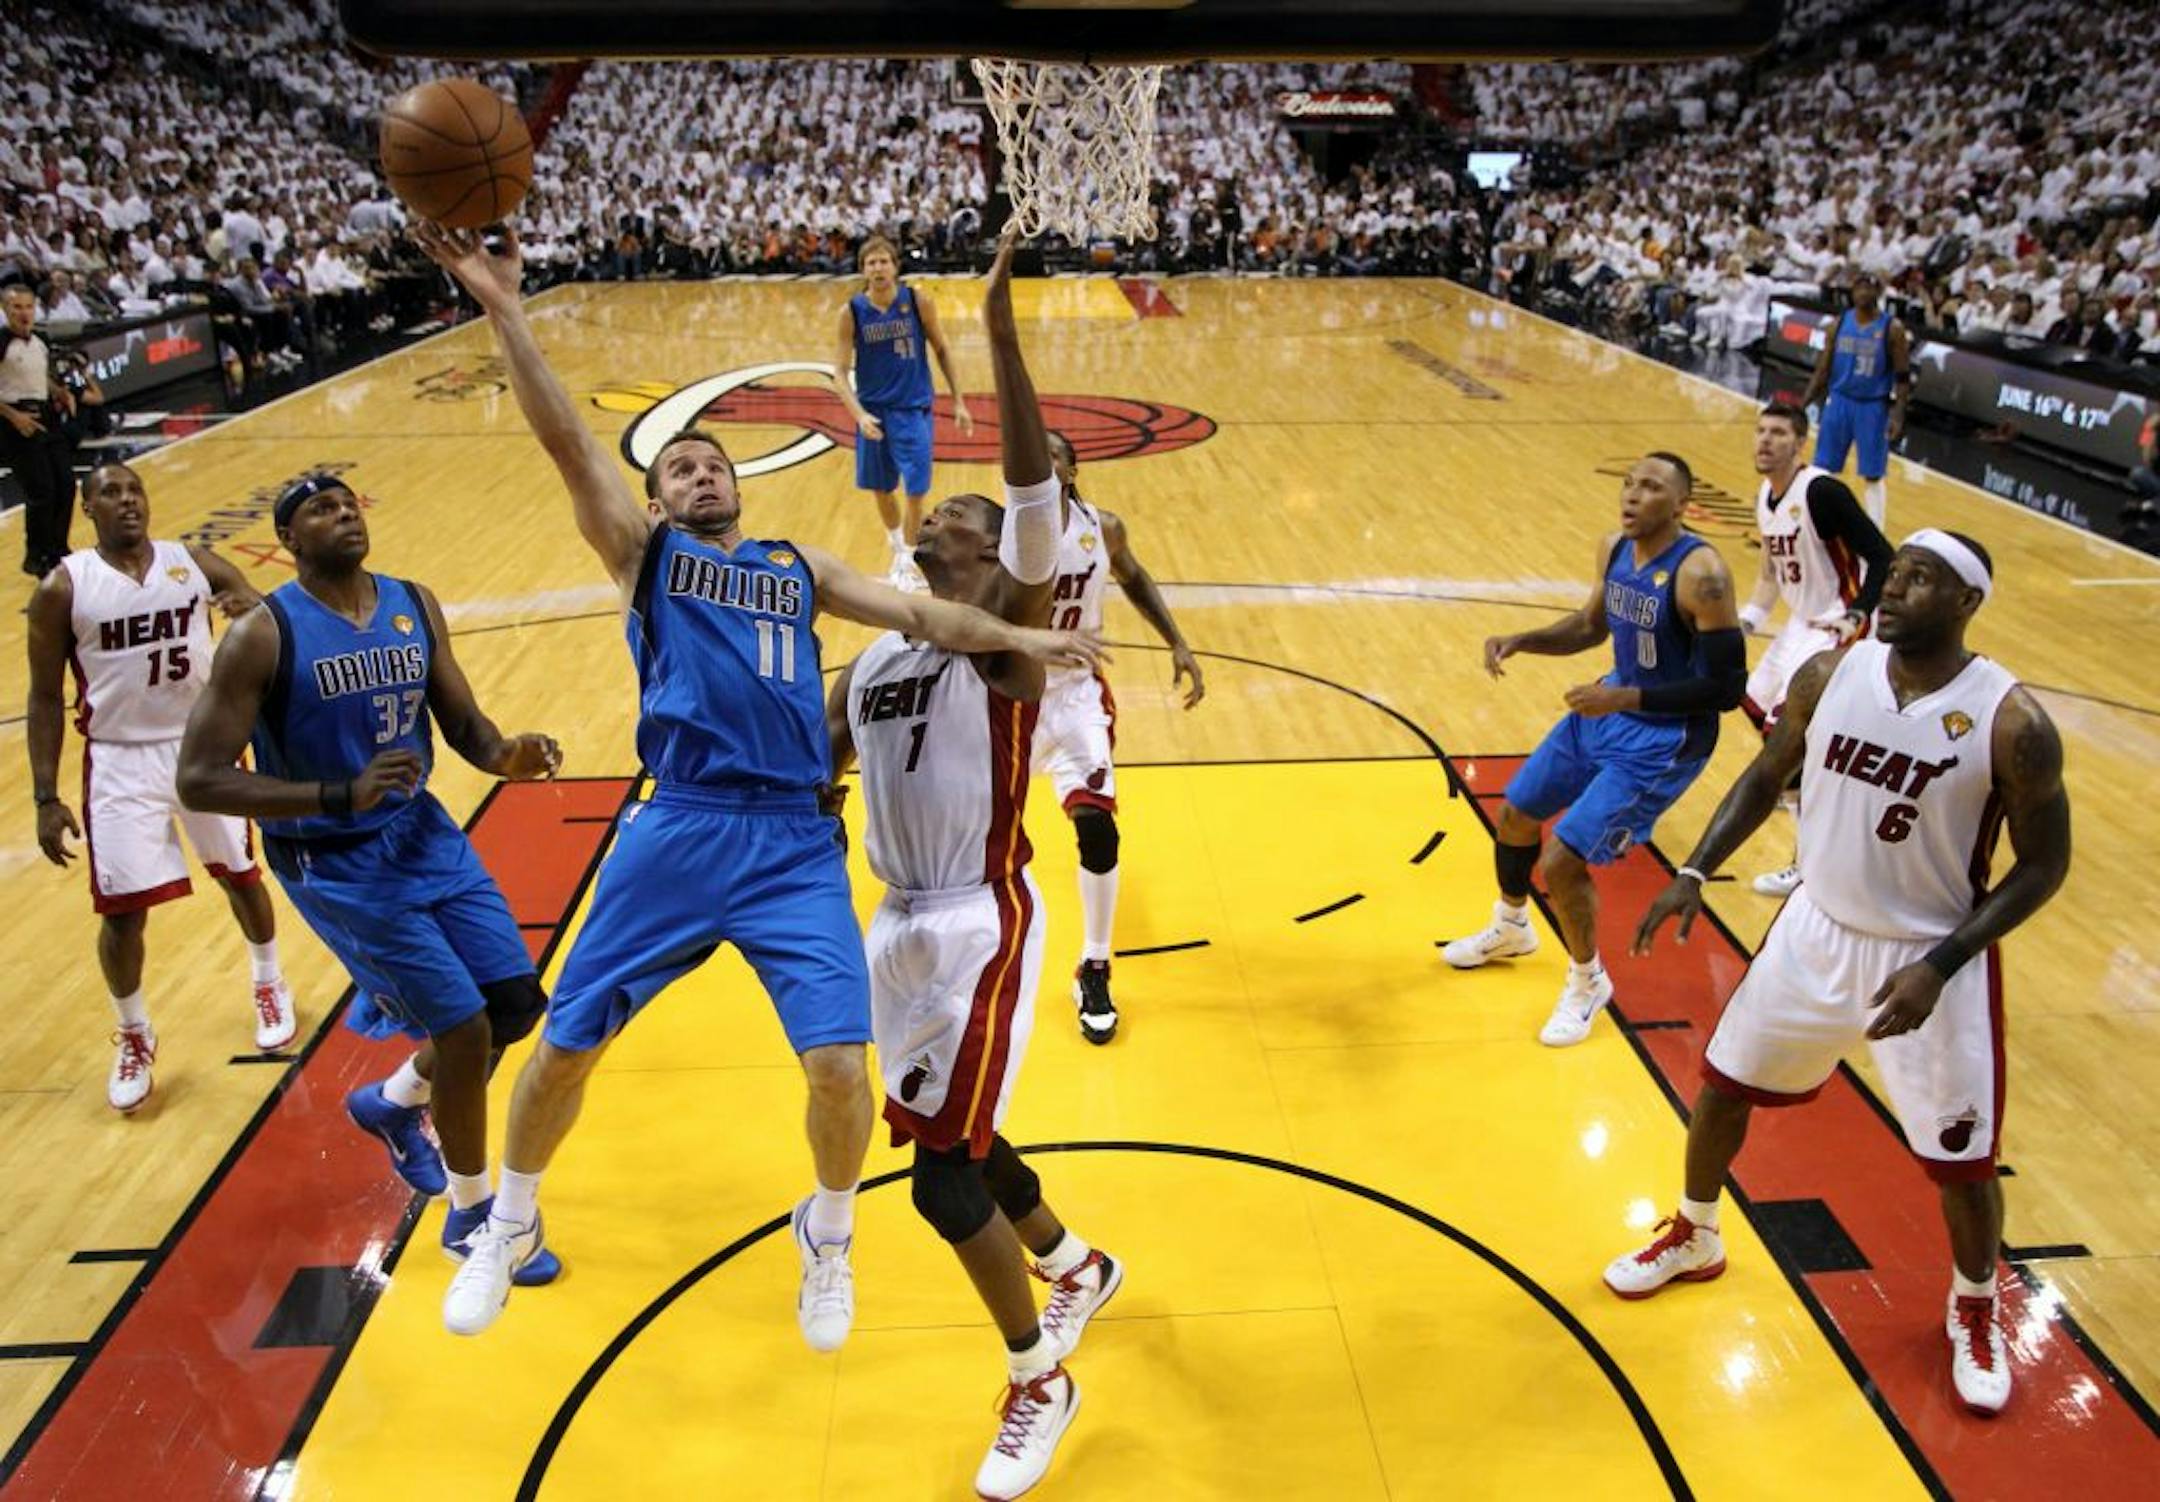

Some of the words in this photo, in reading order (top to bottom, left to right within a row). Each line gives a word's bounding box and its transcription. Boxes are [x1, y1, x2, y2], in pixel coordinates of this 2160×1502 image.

[1996, 383, 2033, 412] JUNE
[2062, 401, 2077, 425] &
[668, 551, 801, 618] DALLAS
[99, 594, 199, 651] HEAT
[755, 619, 794, 682] 11
[1637, 630, 1658, 669] 0
[147, 645, 190, 686] 15
[313, 643, 425, 700] DALLAS
[858, 657, 950, 726] HEAT
[372, 689, 424, 744] 33
[905, 721, 928, 772] 1
[1824, 733, 1960, 800] HEAT
[1875, 803, 1920, 843] 6
